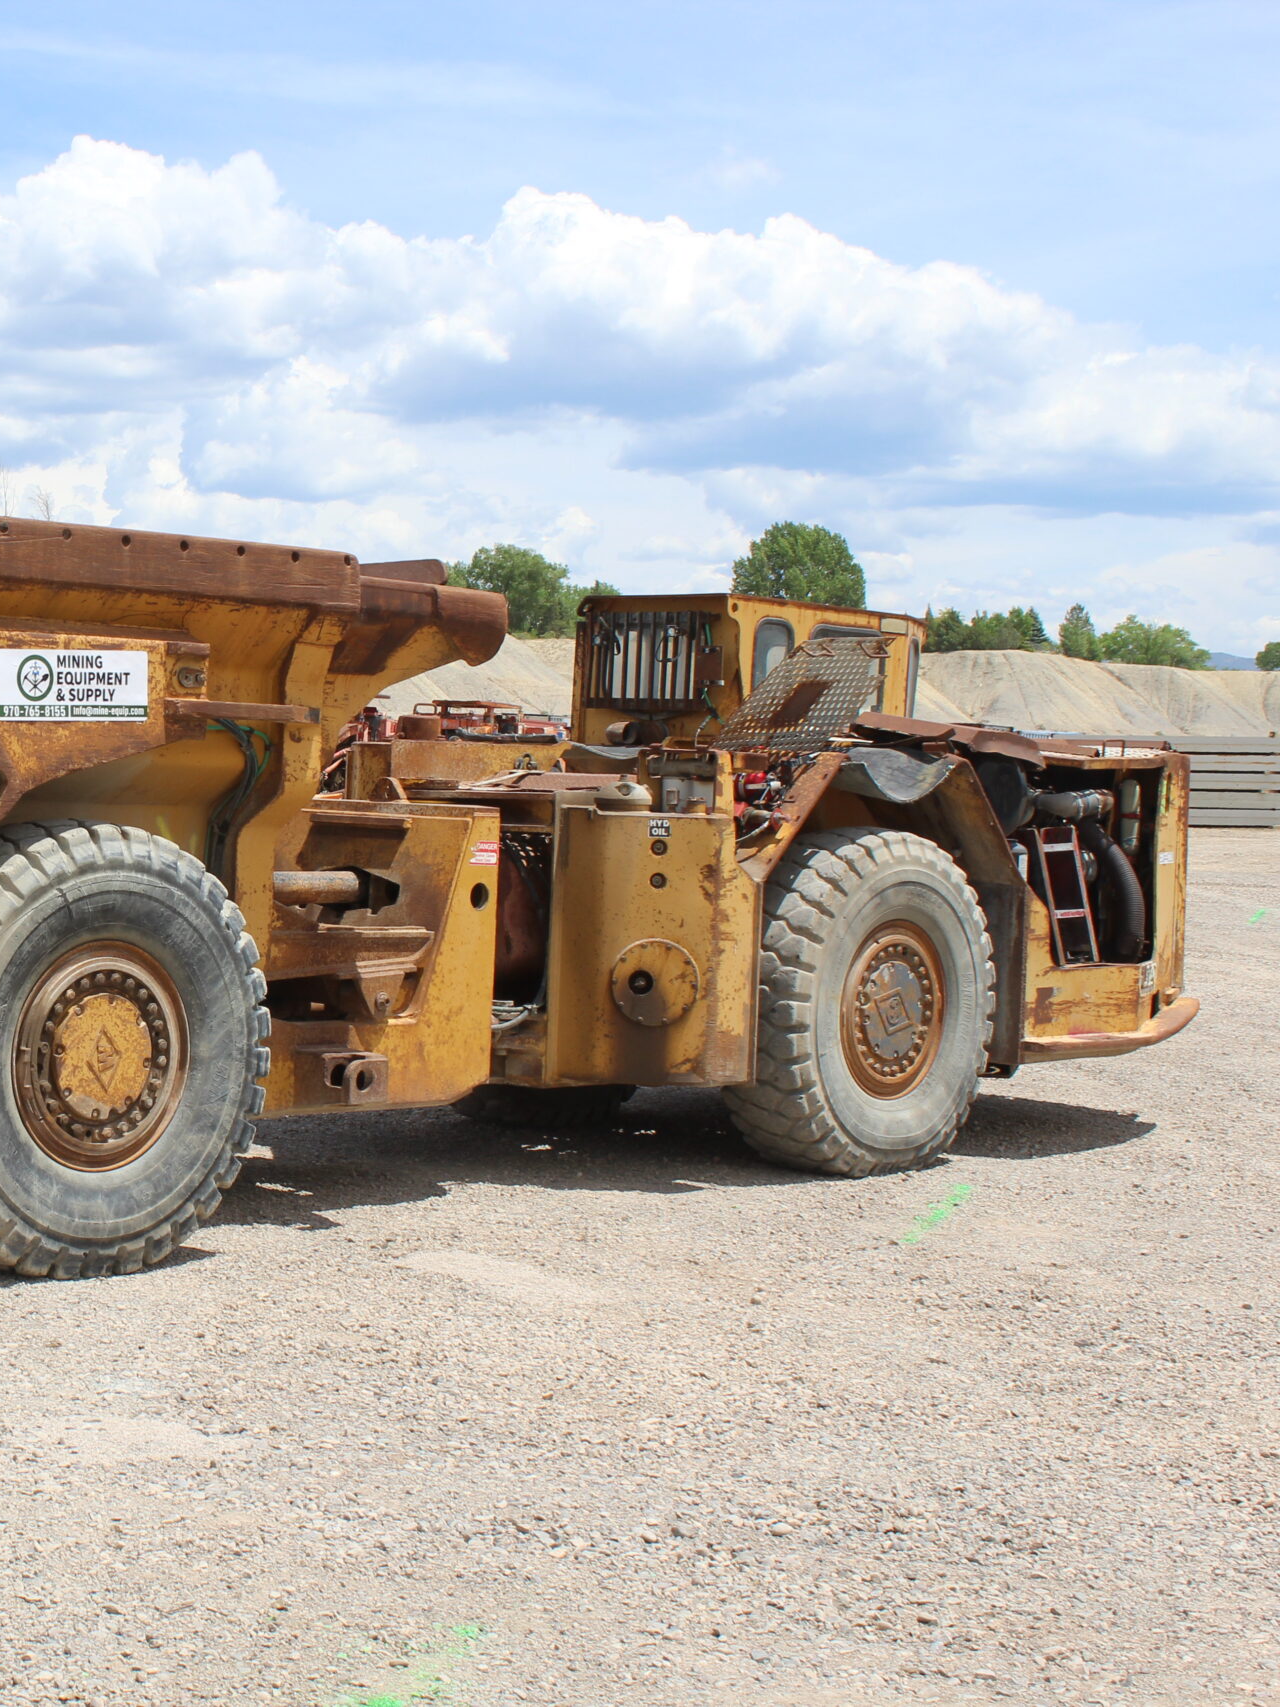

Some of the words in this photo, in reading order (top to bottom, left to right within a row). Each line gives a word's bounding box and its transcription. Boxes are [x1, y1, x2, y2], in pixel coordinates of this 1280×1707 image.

[56, 655, 103, 669] MINING
[56, 672, 130, 686] EQUIPMENT
[56, 689, 65, 701] &
[69, 689, 116, 702] SUPPLY
[3, 706, 66, 717] 970-765-8155
[650, 819, 669, 827] HYD
[651, 827, 668, 836] OIL
